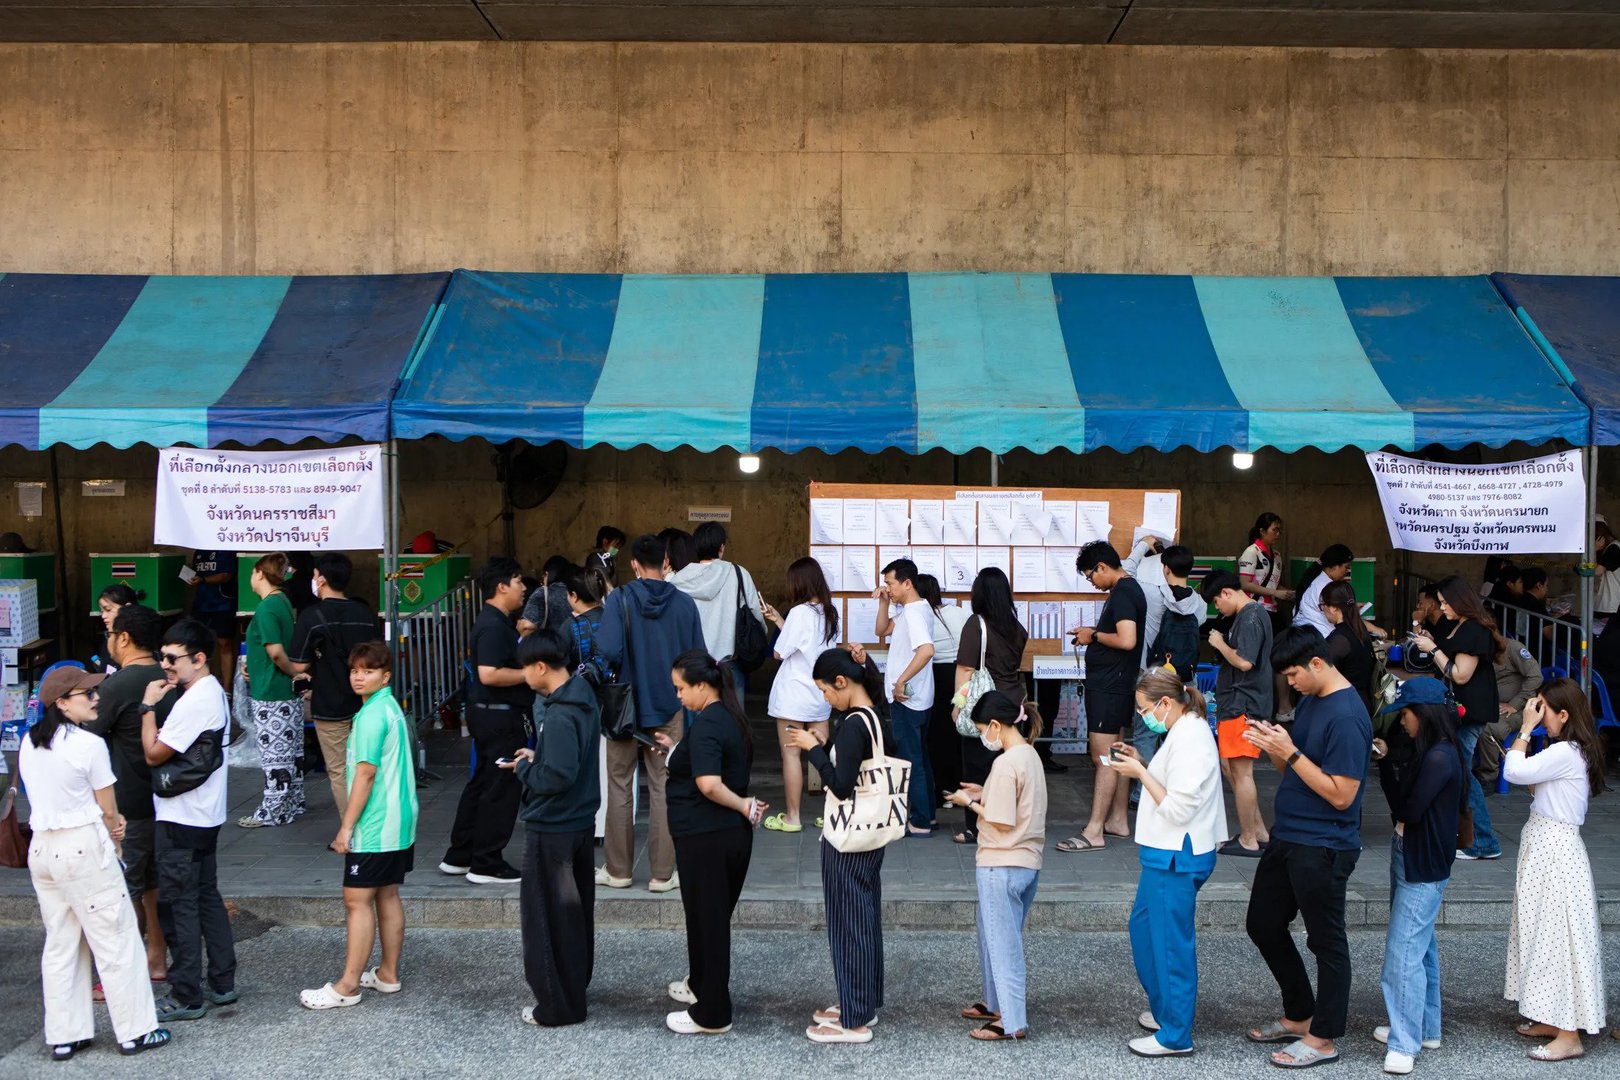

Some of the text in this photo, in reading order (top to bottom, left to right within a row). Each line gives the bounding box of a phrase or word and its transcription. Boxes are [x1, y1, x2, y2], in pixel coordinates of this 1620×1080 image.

[168, 450, 374, 474] ที่เลือกตั้งกลางนอกเขตเลือกตั้ง
[1374, 452, 1574, 476] ที่เลือกตงกลางนอกเขตเลือกตั้ง
[181, 481, 201, 496] ชุดที่
[202, 485, 208, 494] 8
[210, 481, 241, 494] ลำดับที่
[242, 484, 292, 494] 5138-5783
[313, 484, 362, 494] 8949-9047
[1386, 478, 1403, 490] ชุดที่
[1404, 481, 1409, 489] 7
[1410, 480, 1433, 490] ลำดับที่
[1522, 480, 1564, 489] 4728-4979
[1482, 493, 1523, 501] 7976-8082
[206, 503, 336, 521] จังหวัดนครราชสีมา
[1398, 502, 1549, 518] จังหวัดตาก จังหวัดนครนายก
[1472, 521, 1557, 535] จังหวัดนครพนม
[216, 526, 330, 548] จังหวัดปราจีนบุรี
[1433, 537, 1510, 551] จังหวัดบึงกาฬ
[956, 570, 965, 581] 3
